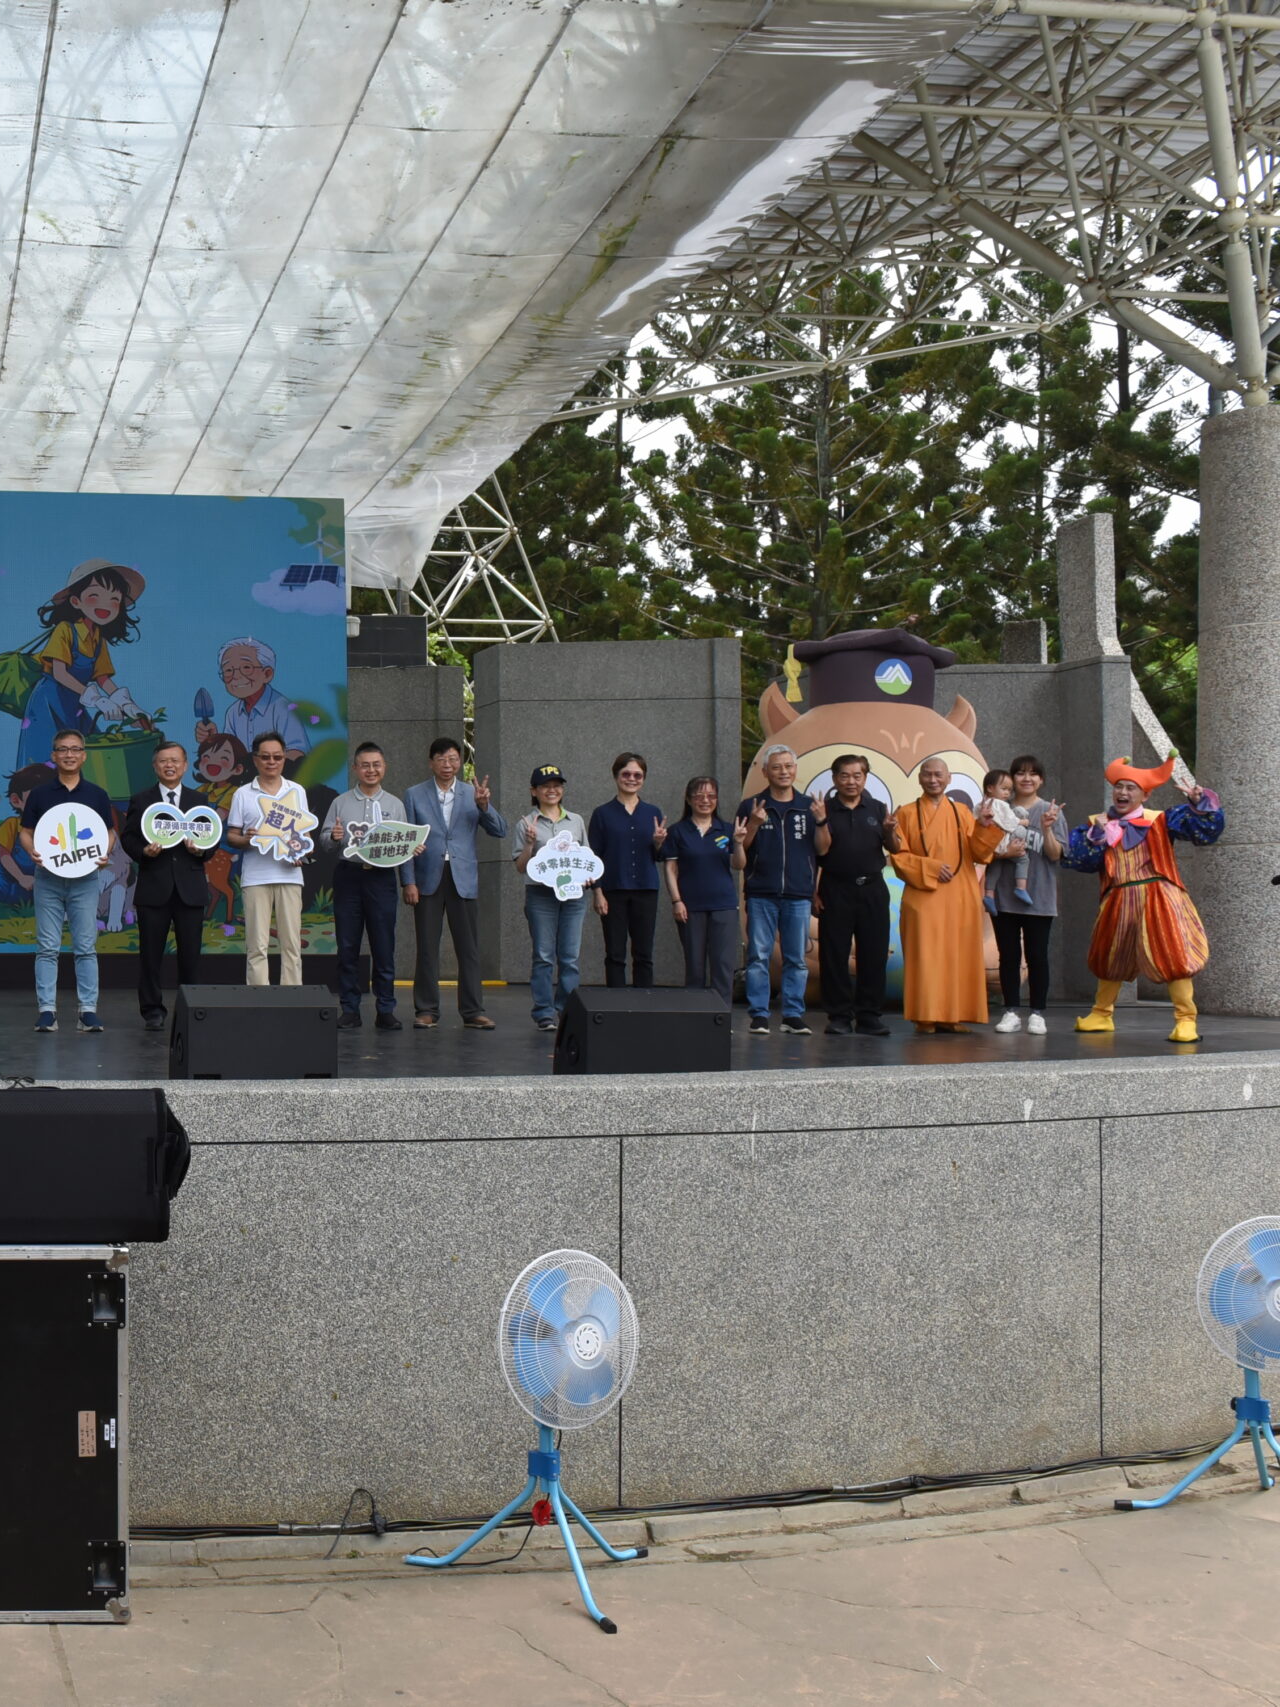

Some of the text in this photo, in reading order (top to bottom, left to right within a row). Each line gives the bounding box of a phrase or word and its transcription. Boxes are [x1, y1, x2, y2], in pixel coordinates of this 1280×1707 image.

[265, 809, 296, 832] 超人
[368, 830, 418, 845] 綠能永續
[49, 844, 103, 869] TAIPEI
[368, 844, 410, 860] 護地球
[535, 857, 596, 875] 淨零綠生活
